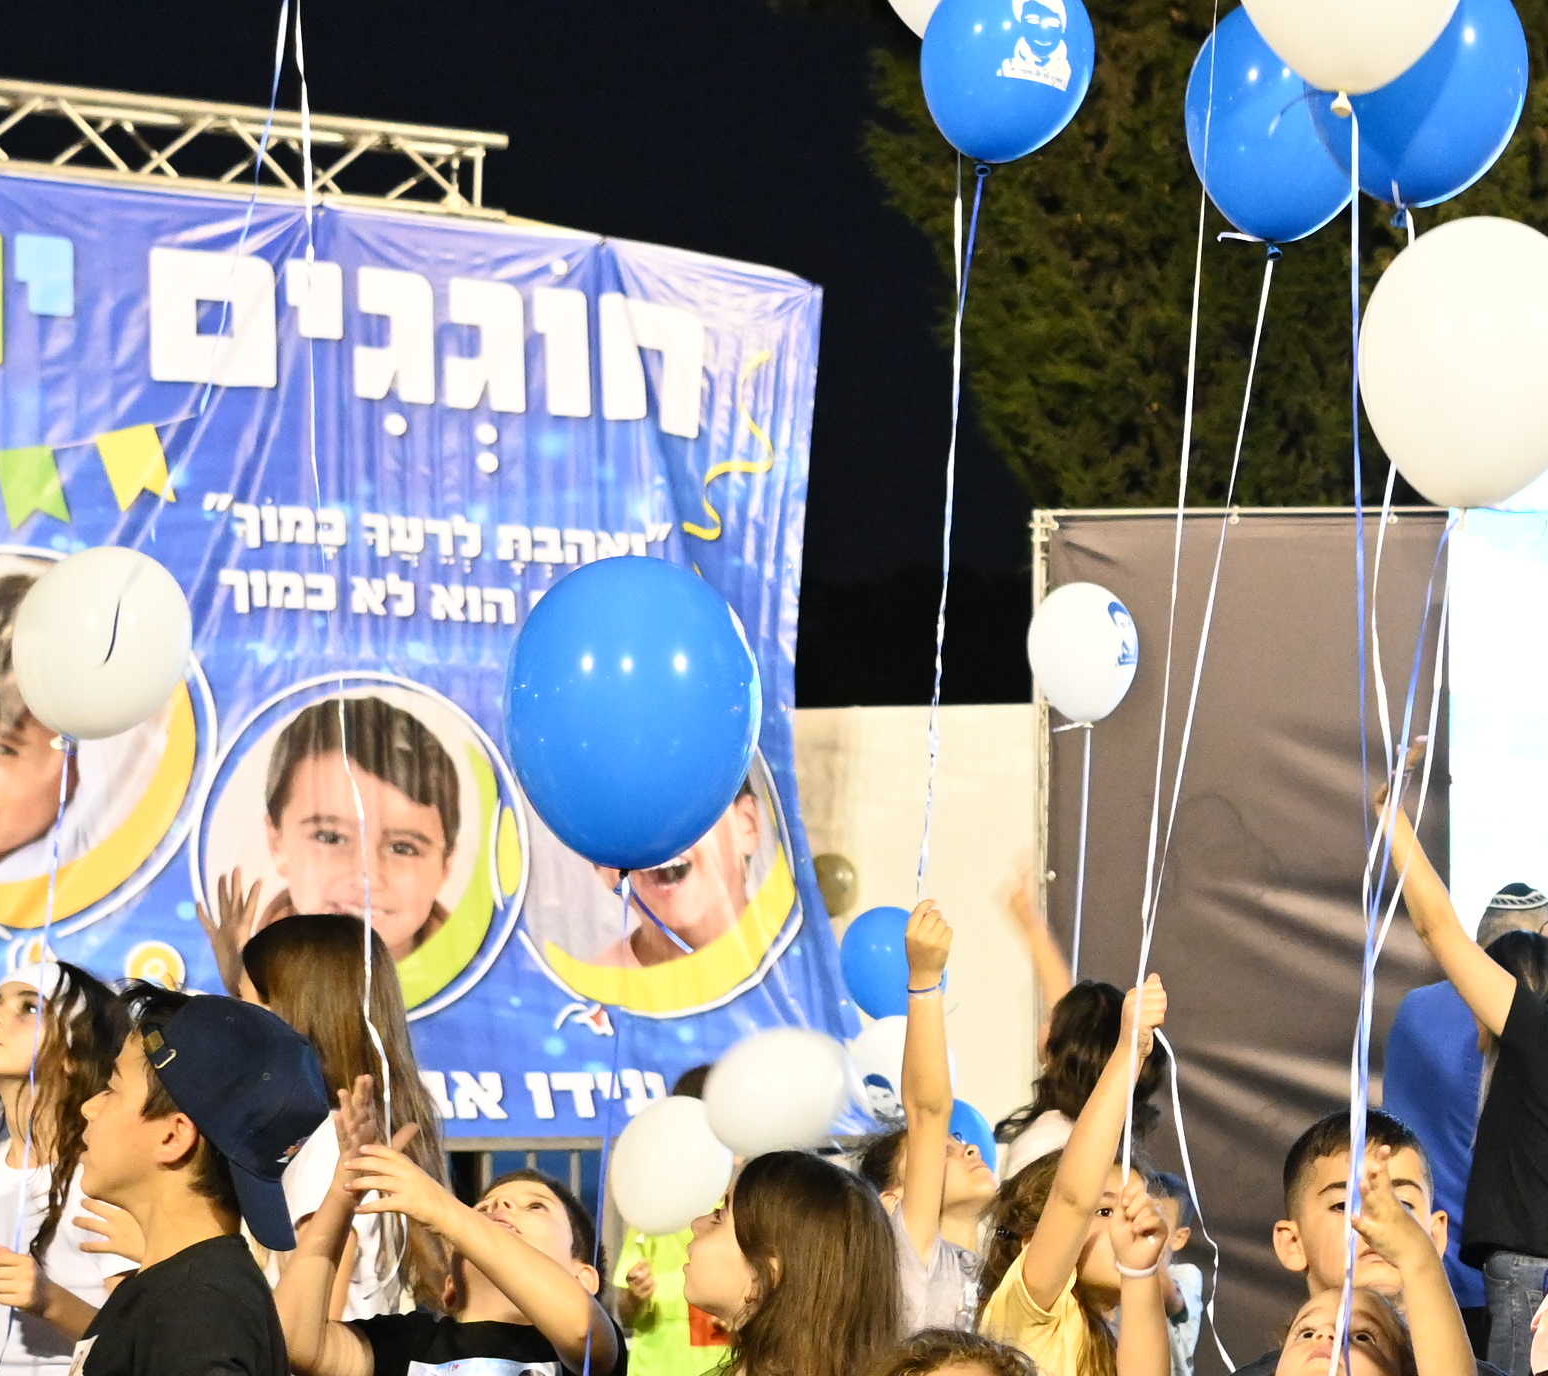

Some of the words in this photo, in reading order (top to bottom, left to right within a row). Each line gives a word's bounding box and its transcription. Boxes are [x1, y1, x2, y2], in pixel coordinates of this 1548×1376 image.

[219, 569, 338, 614] כמוך
[352, 573, 415, 617] לא
[430, 583, 517, 625] הוא
